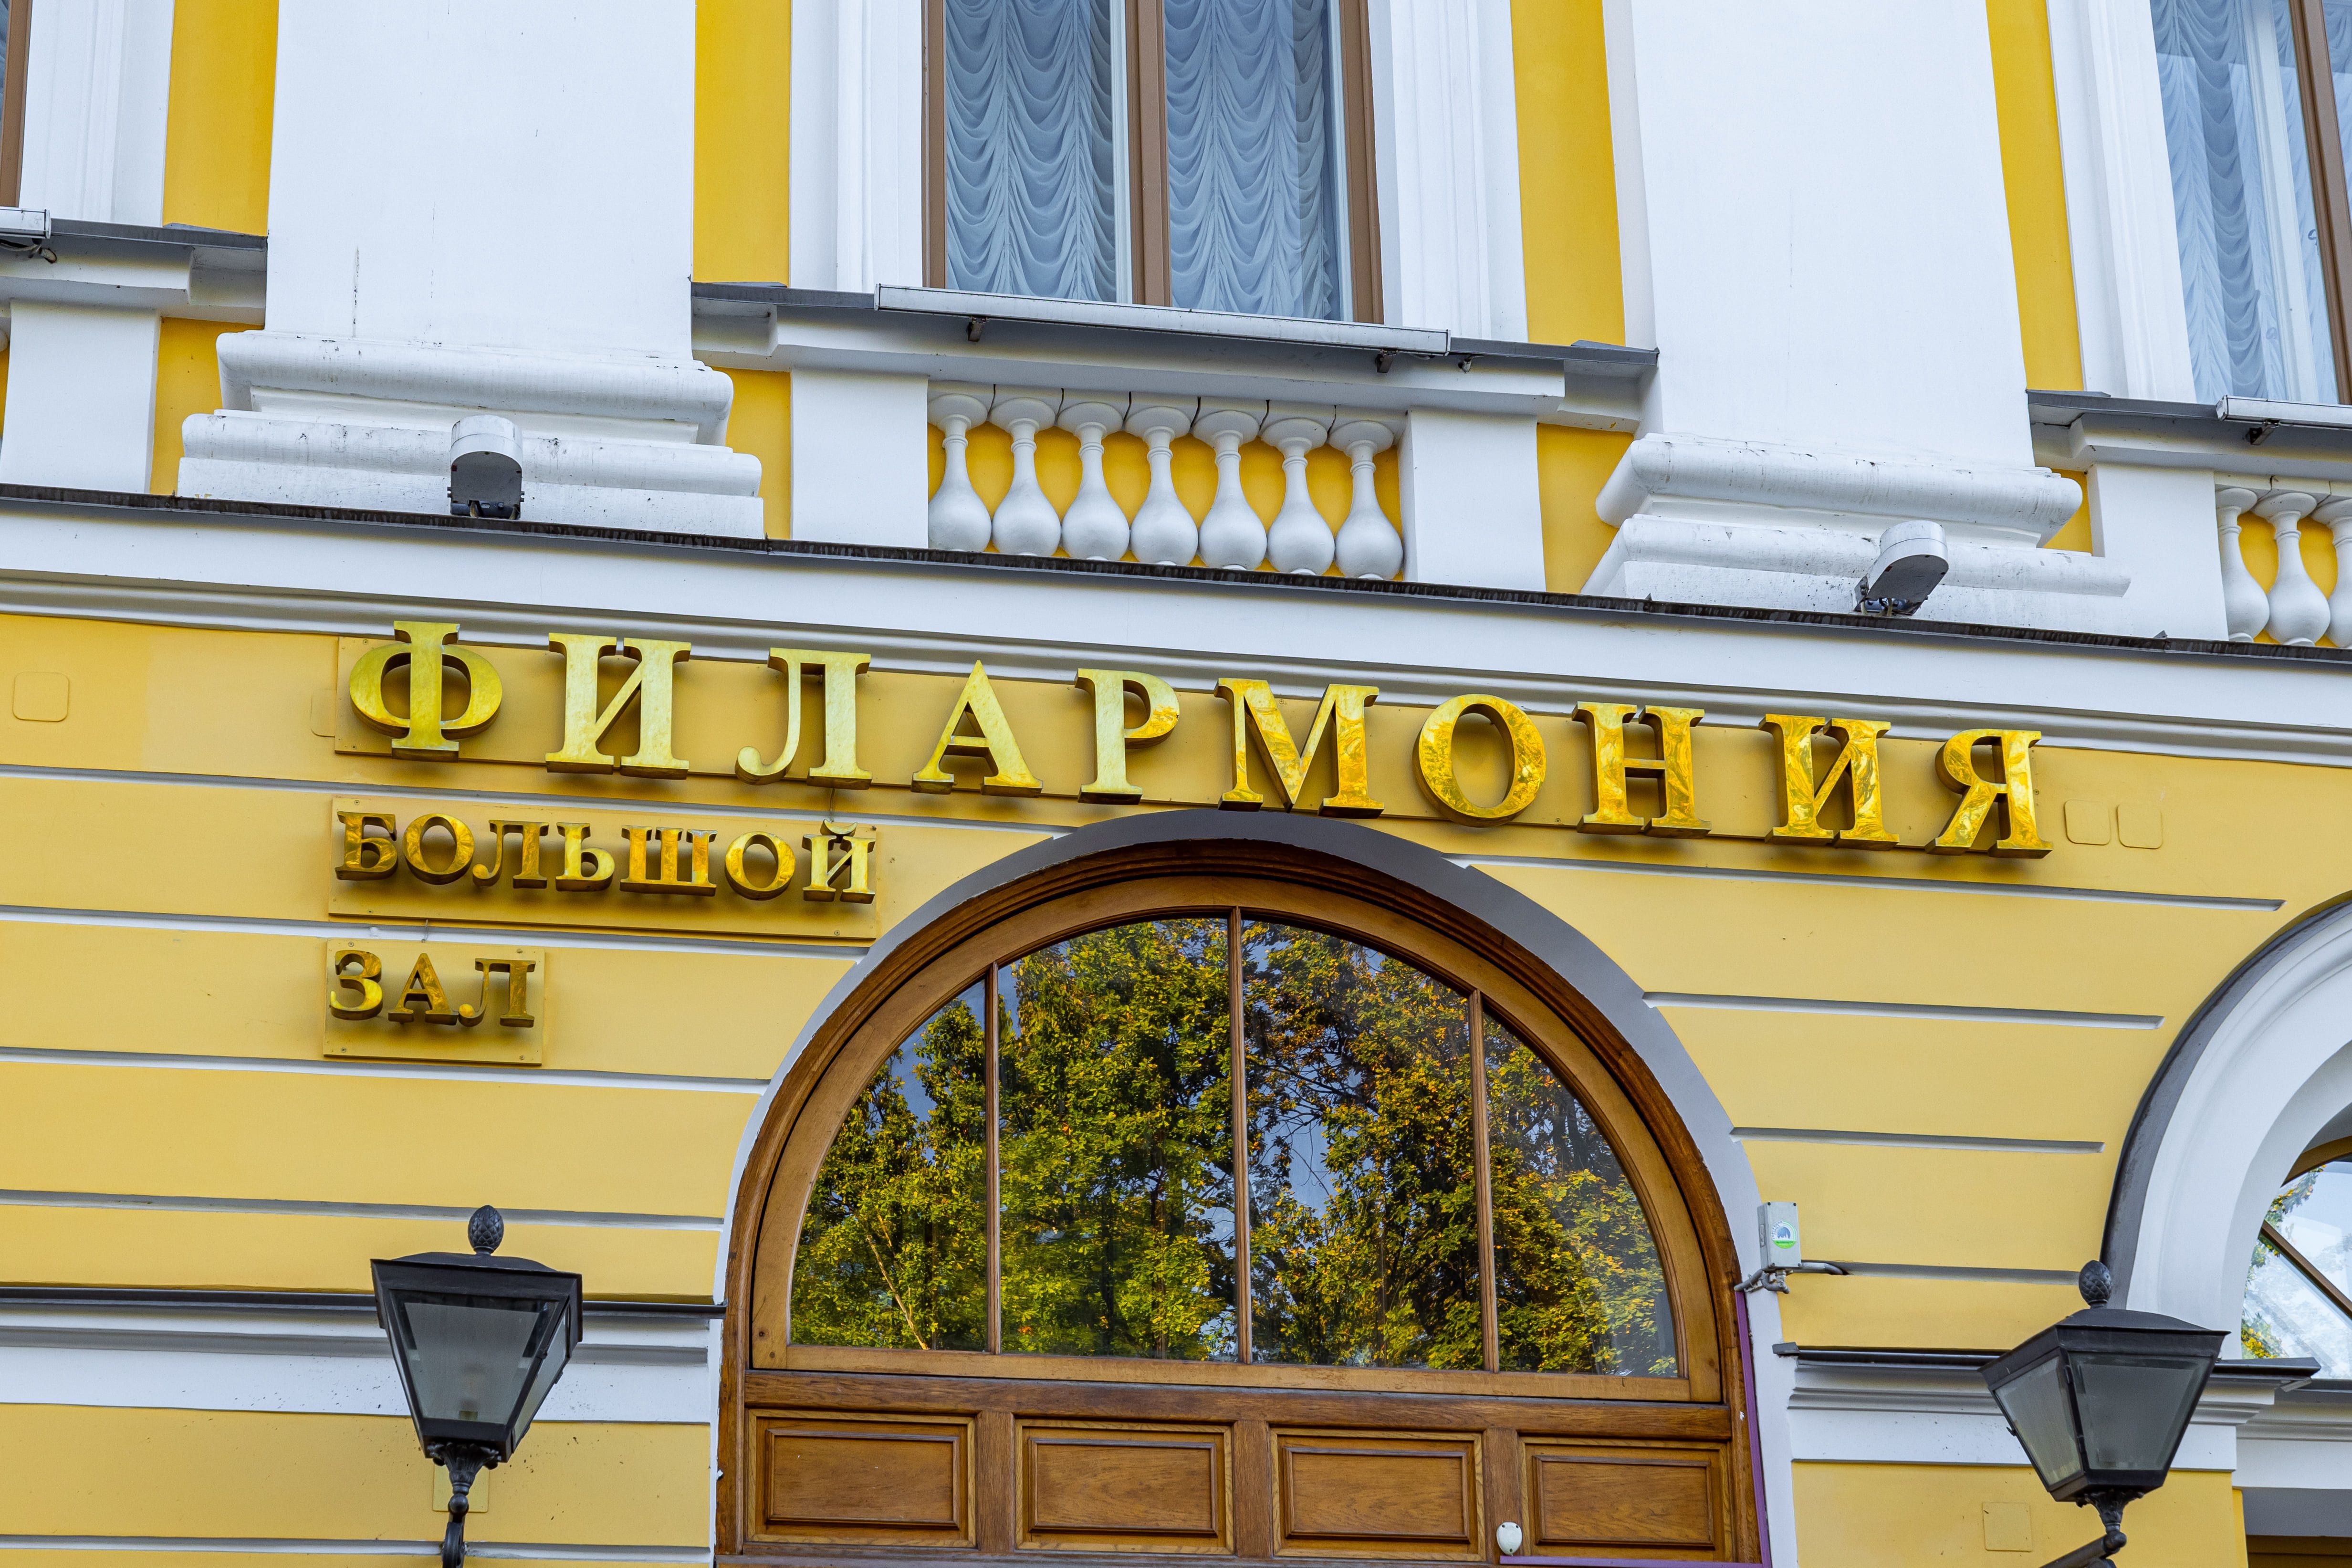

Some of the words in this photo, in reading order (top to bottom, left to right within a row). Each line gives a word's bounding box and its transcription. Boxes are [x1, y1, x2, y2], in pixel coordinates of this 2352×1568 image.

[349, 622, 2052, 859] ФИЛАРМОНИЯ
[335, 811, 876, 904] БОЛЬШОЙ
[329, 949, 536, 1027] ЗАЛ
